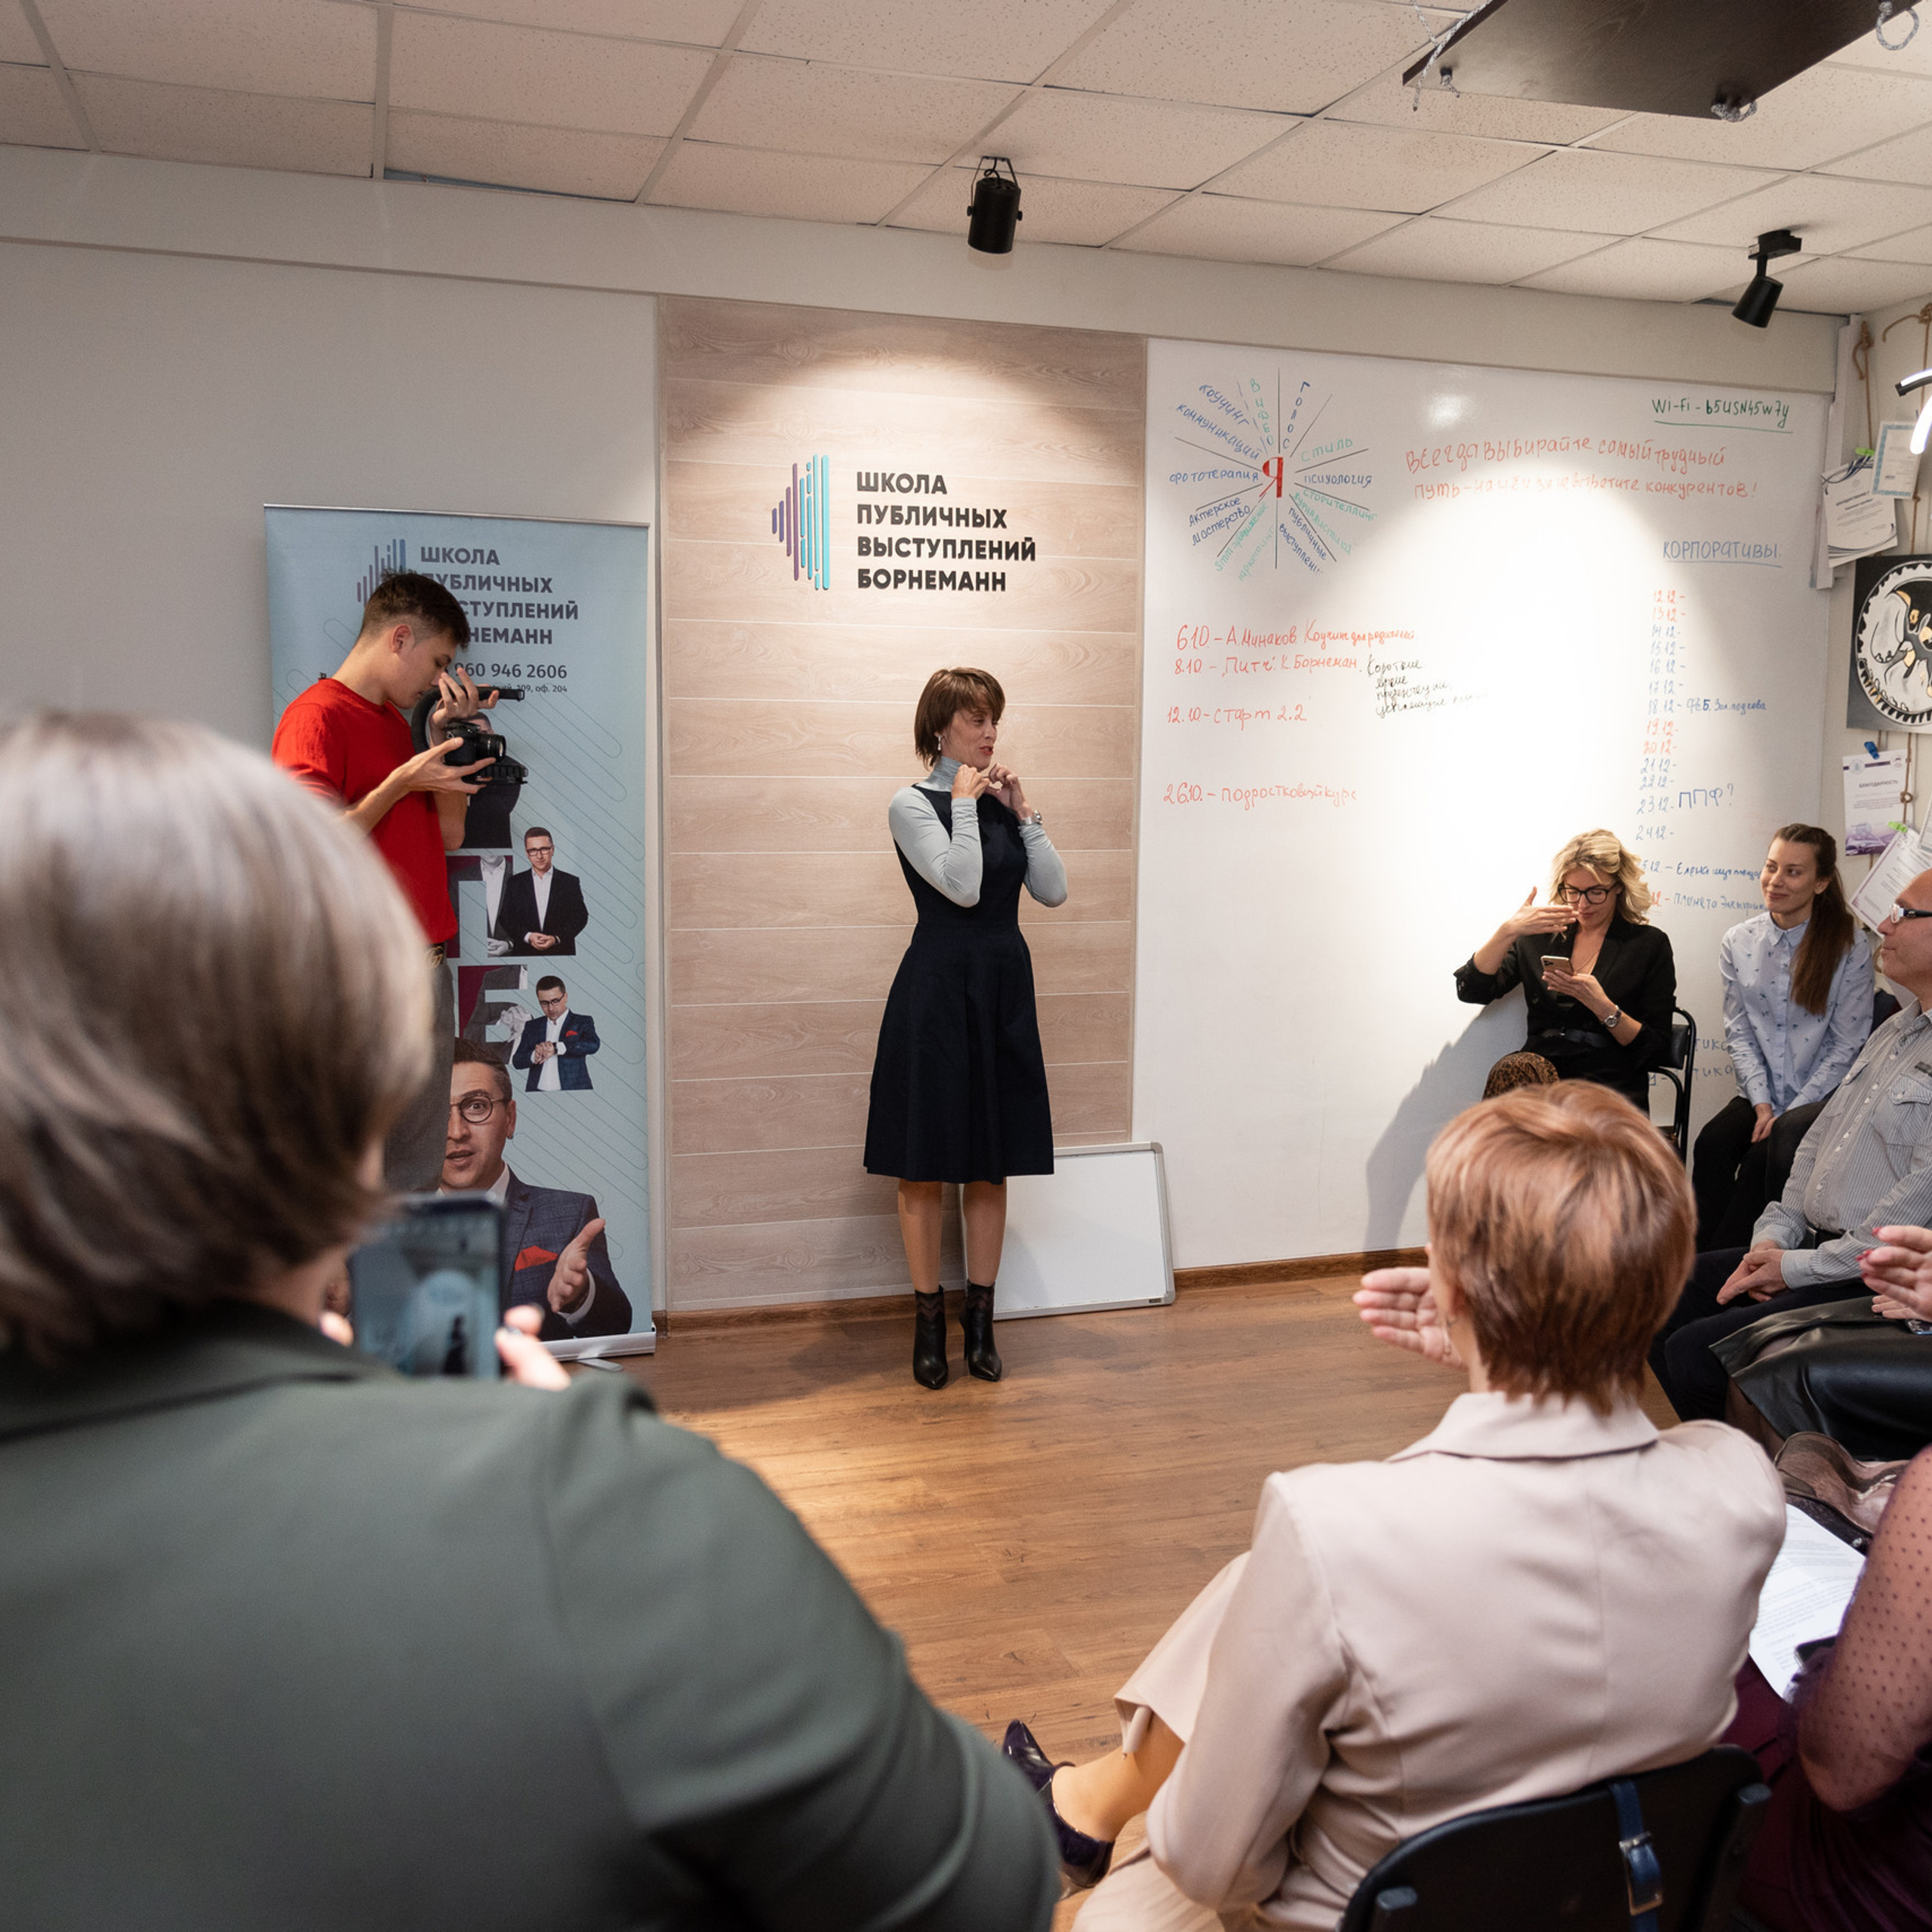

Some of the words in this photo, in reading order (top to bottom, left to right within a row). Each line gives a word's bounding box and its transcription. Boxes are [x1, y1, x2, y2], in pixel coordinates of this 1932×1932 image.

[857, 471, 948, 495] ШКОЛА
[857, 503, 1008, 529] ПУБЛИЧНЫХ
[420, 545, 501, 566] ШКОЛА
[857, 536, 1036, 561] ВЫСТУПЛЕНИЙ
[857, 568, 1006, 592] БОРНЕМАНН
[457, 600, 579, 620] СТУПЛЕНИЙ
[469, 627, 552, 645] НЕМАНН
[491, 663, 521, 678] 946
[527, 664, 568, 679] 2606
[535, 685, 550, 694] оф.
